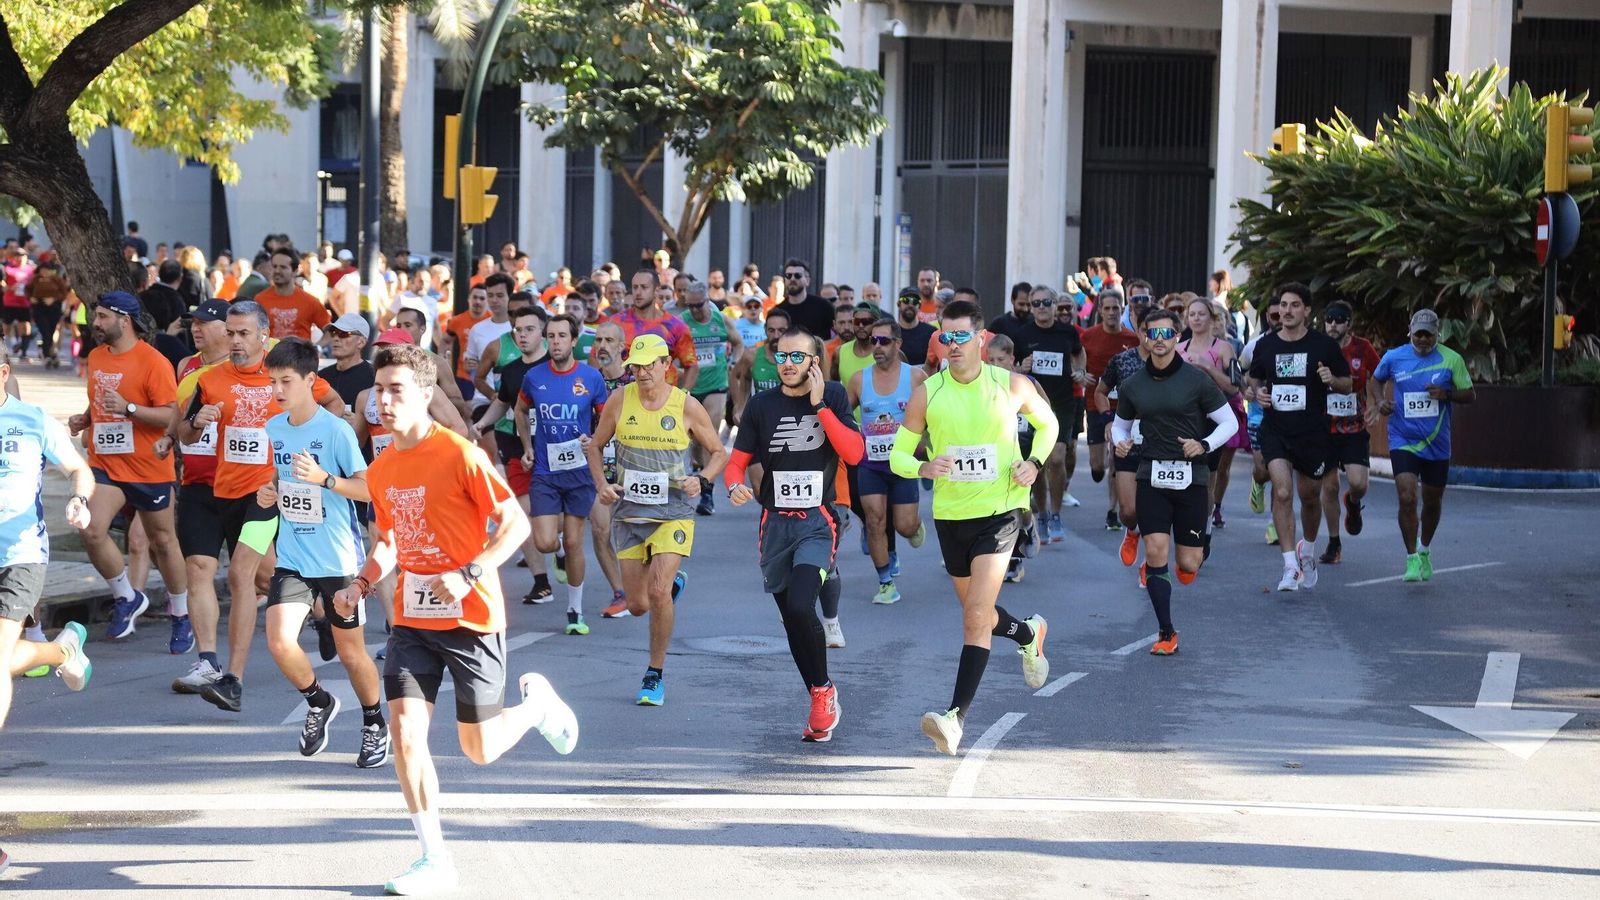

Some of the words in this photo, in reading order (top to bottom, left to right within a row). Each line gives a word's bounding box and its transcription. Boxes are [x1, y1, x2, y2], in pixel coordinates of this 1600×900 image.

[1036, 359, 1057, 368] 270
[1276, 394, 1299, 403] 742
[1408, 400, 1432, 410] 937
[540, 403, 578, 420] RCM
[98, 433, 126, 445] 592
[229, 439, 259, 453] 862
[558, 450, 575, 462] 45
[952, 458, 987, 471] 111
[1157, 471, 1185, 480] 843
[630, 483, 660, 495] 439
[781, 484, 812, 496] 811
[282, 495, 312, 511] 925
[414, 591, 442, 605] 72
